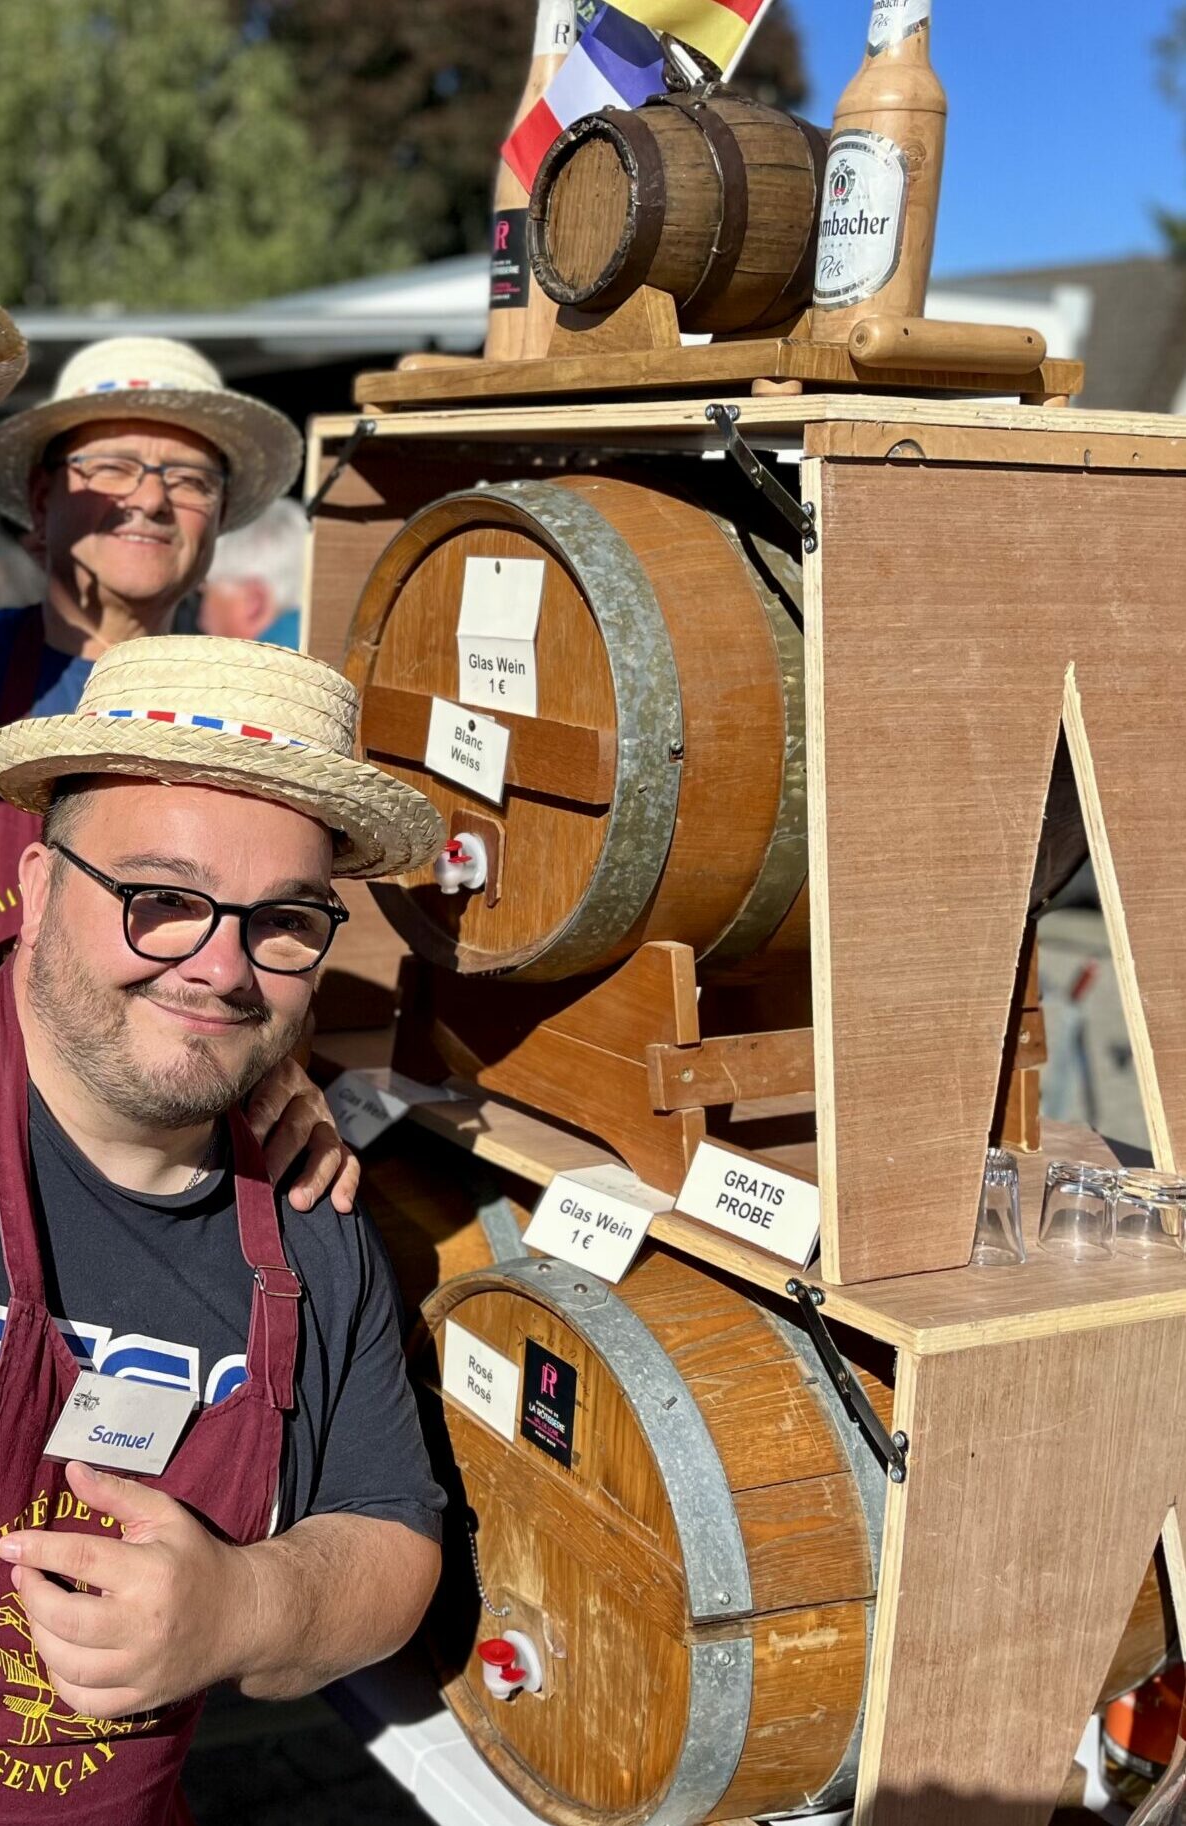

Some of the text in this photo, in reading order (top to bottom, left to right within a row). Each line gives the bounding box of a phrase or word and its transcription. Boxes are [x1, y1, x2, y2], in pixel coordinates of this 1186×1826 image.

[820, 255, 844, 281] Pils
[469, 653, 526, 675] Glas Wein
[489, 678, 506, 694] 1 €
[455, 727, 483, 751] Blanc
[451, 745, 480, 771] Weiss
[724, 1170, 785, 1206] GRATIS
[559, 1199, 633, 1240] Glas Wein
[716, 1193, 774, 1229] PROBE
[572, 1229, 594, 1250] 1 €
[469, 1355, 493, 1383] Rosé
[467, 1376, 491, 1404] Rosé
[88, 1425, 155, 1450] Samuel
[55, 1491, 91, 1521] DE
